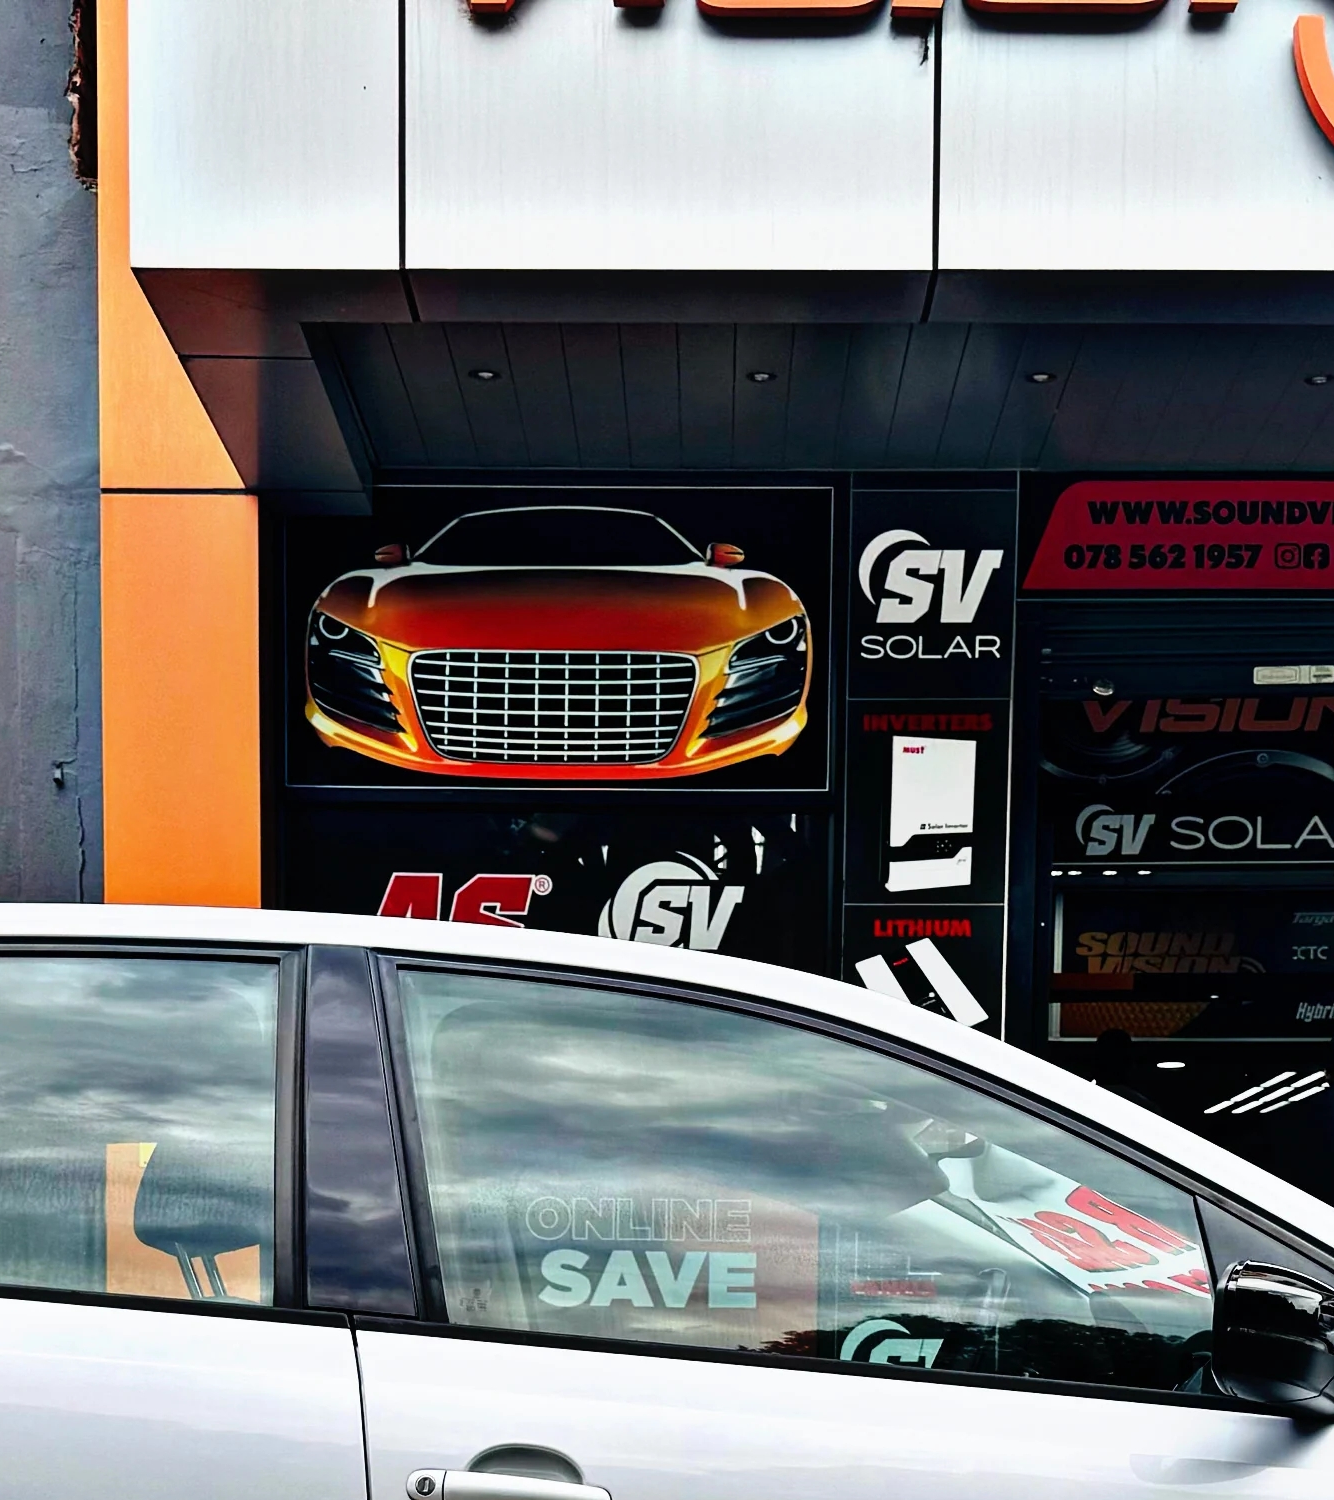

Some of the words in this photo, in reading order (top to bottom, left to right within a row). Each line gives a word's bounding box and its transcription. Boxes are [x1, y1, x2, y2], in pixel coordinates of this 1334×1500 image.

[1064, 544, 1121, 570] 078
[1128, 544, 1186, 570] 562
[1193, 544, 1263, 570] 1957
[876, 549, 1004, 623] SV
[860, 635, 1001, 659] SOLAR
[863, 713, 993, 732] INVERTERS
[1085, 814, 1156, 856] SV
[873, 918, 972, 938] LITHIUM
[1075, 931, 1236, 958] SOUND
[525, 1195, 753, 1243] ONLINE
[539, 1249, 758, 1309] SAVE
